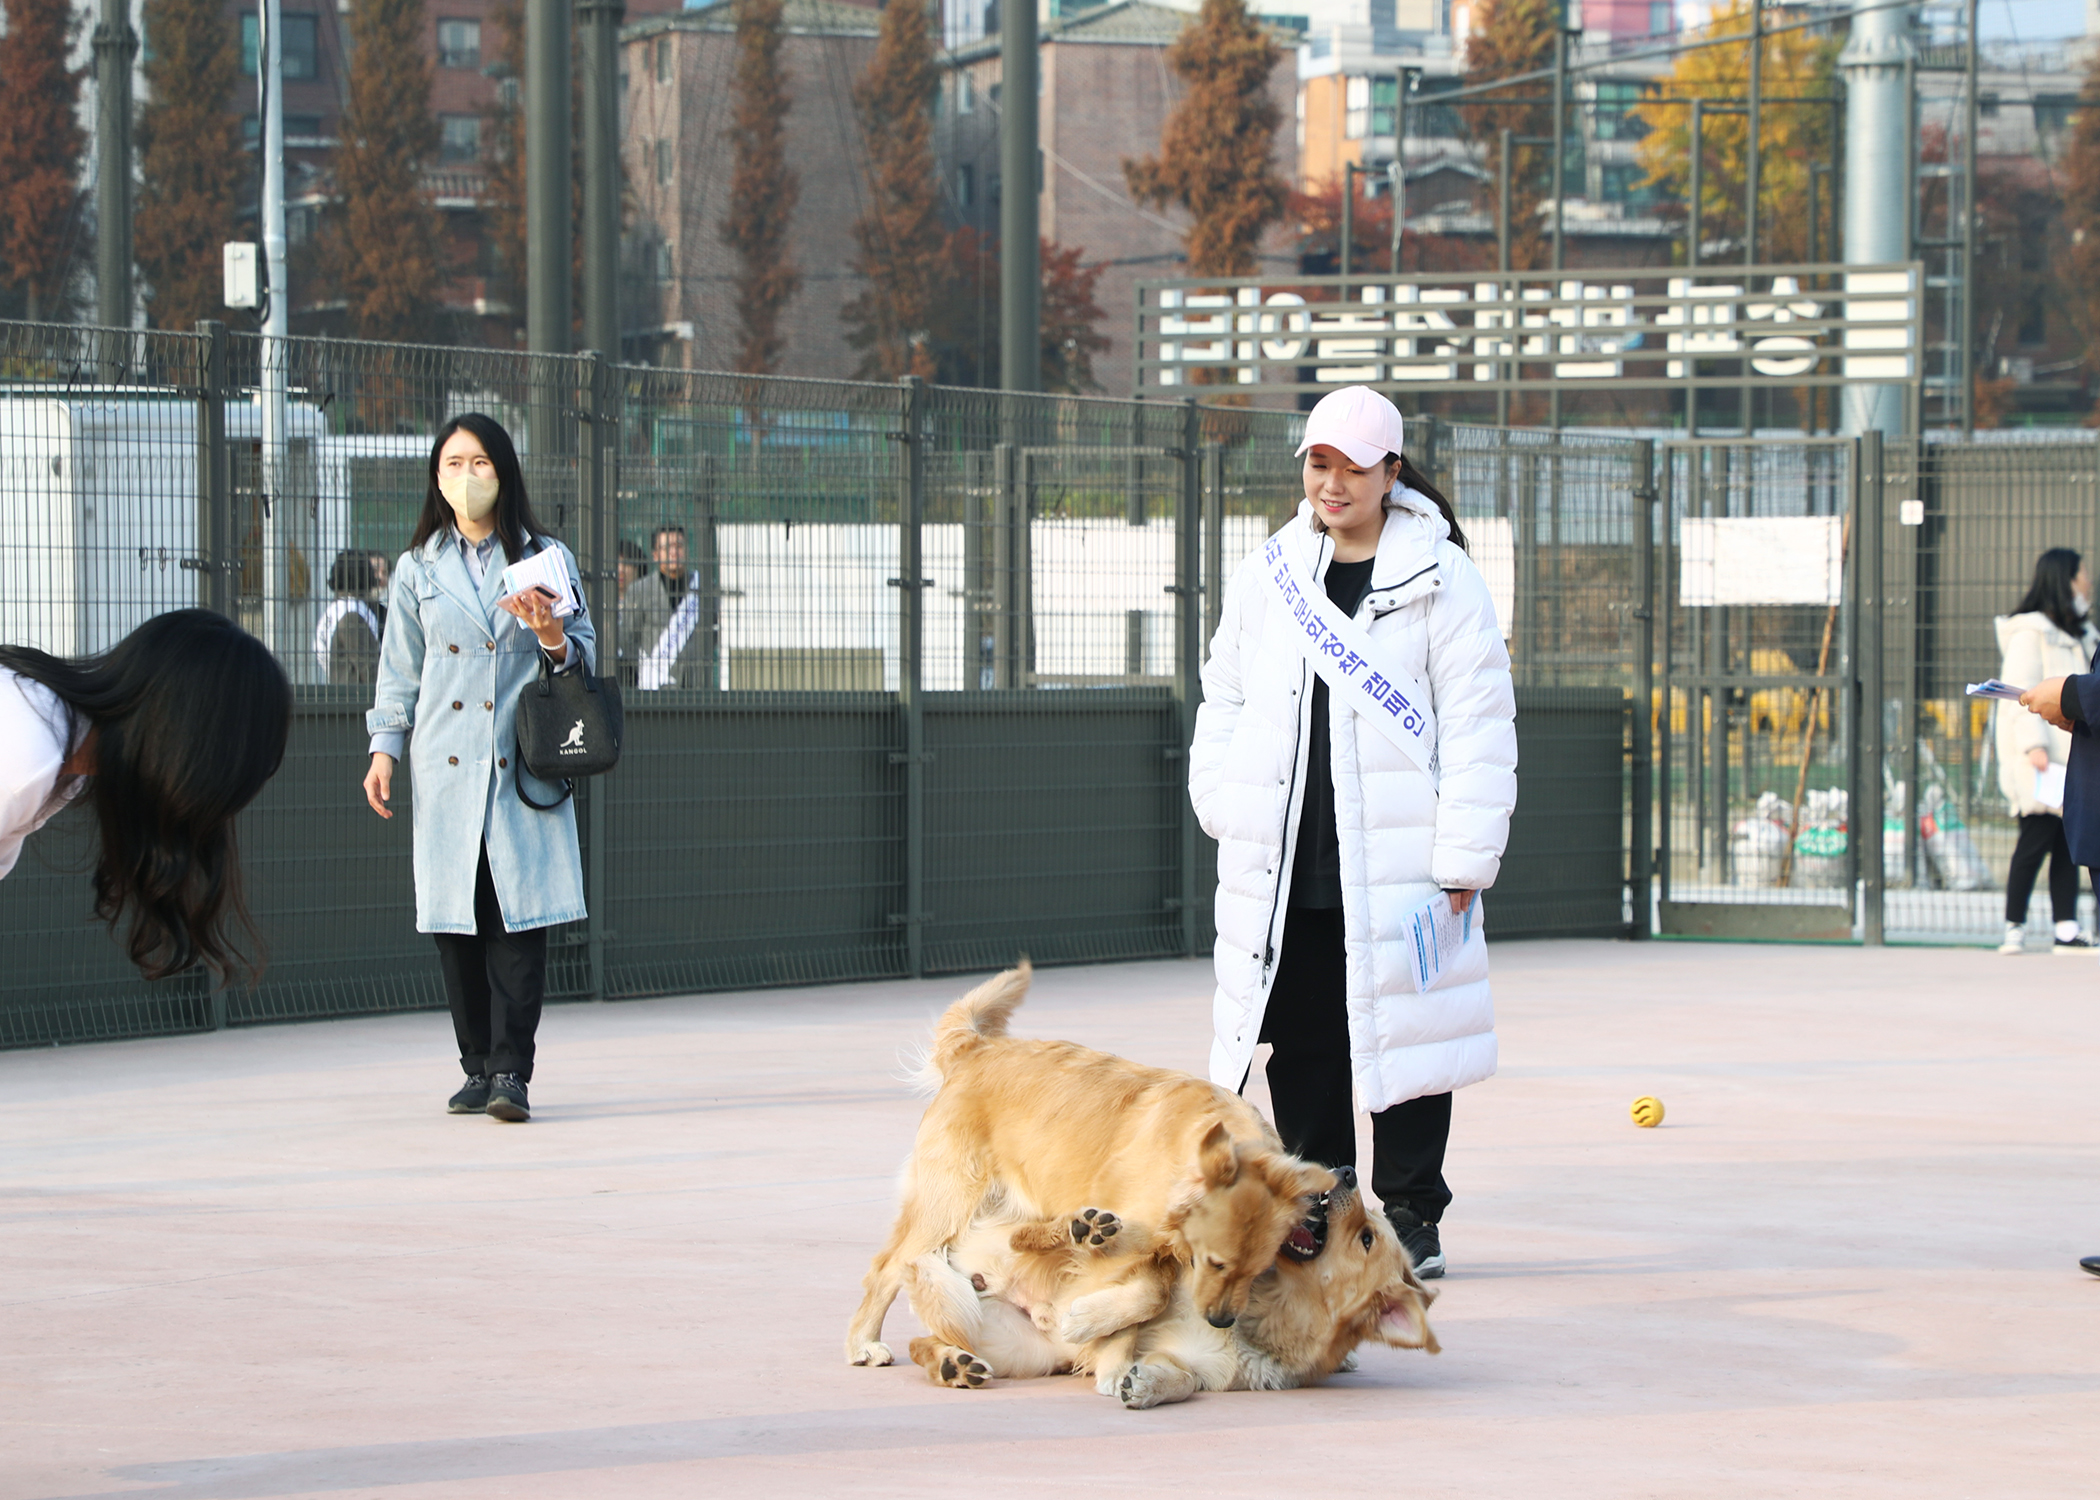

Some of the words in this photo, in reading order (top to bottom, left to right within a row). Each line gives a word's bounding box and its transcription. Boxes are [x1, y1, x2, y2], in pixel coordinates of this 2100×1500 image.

[1275, 562, 1369, 676] 반려문화정책
[1361, 670, 1427, 738] 캠페인
[559, 747, 588, 756] KANGOL
